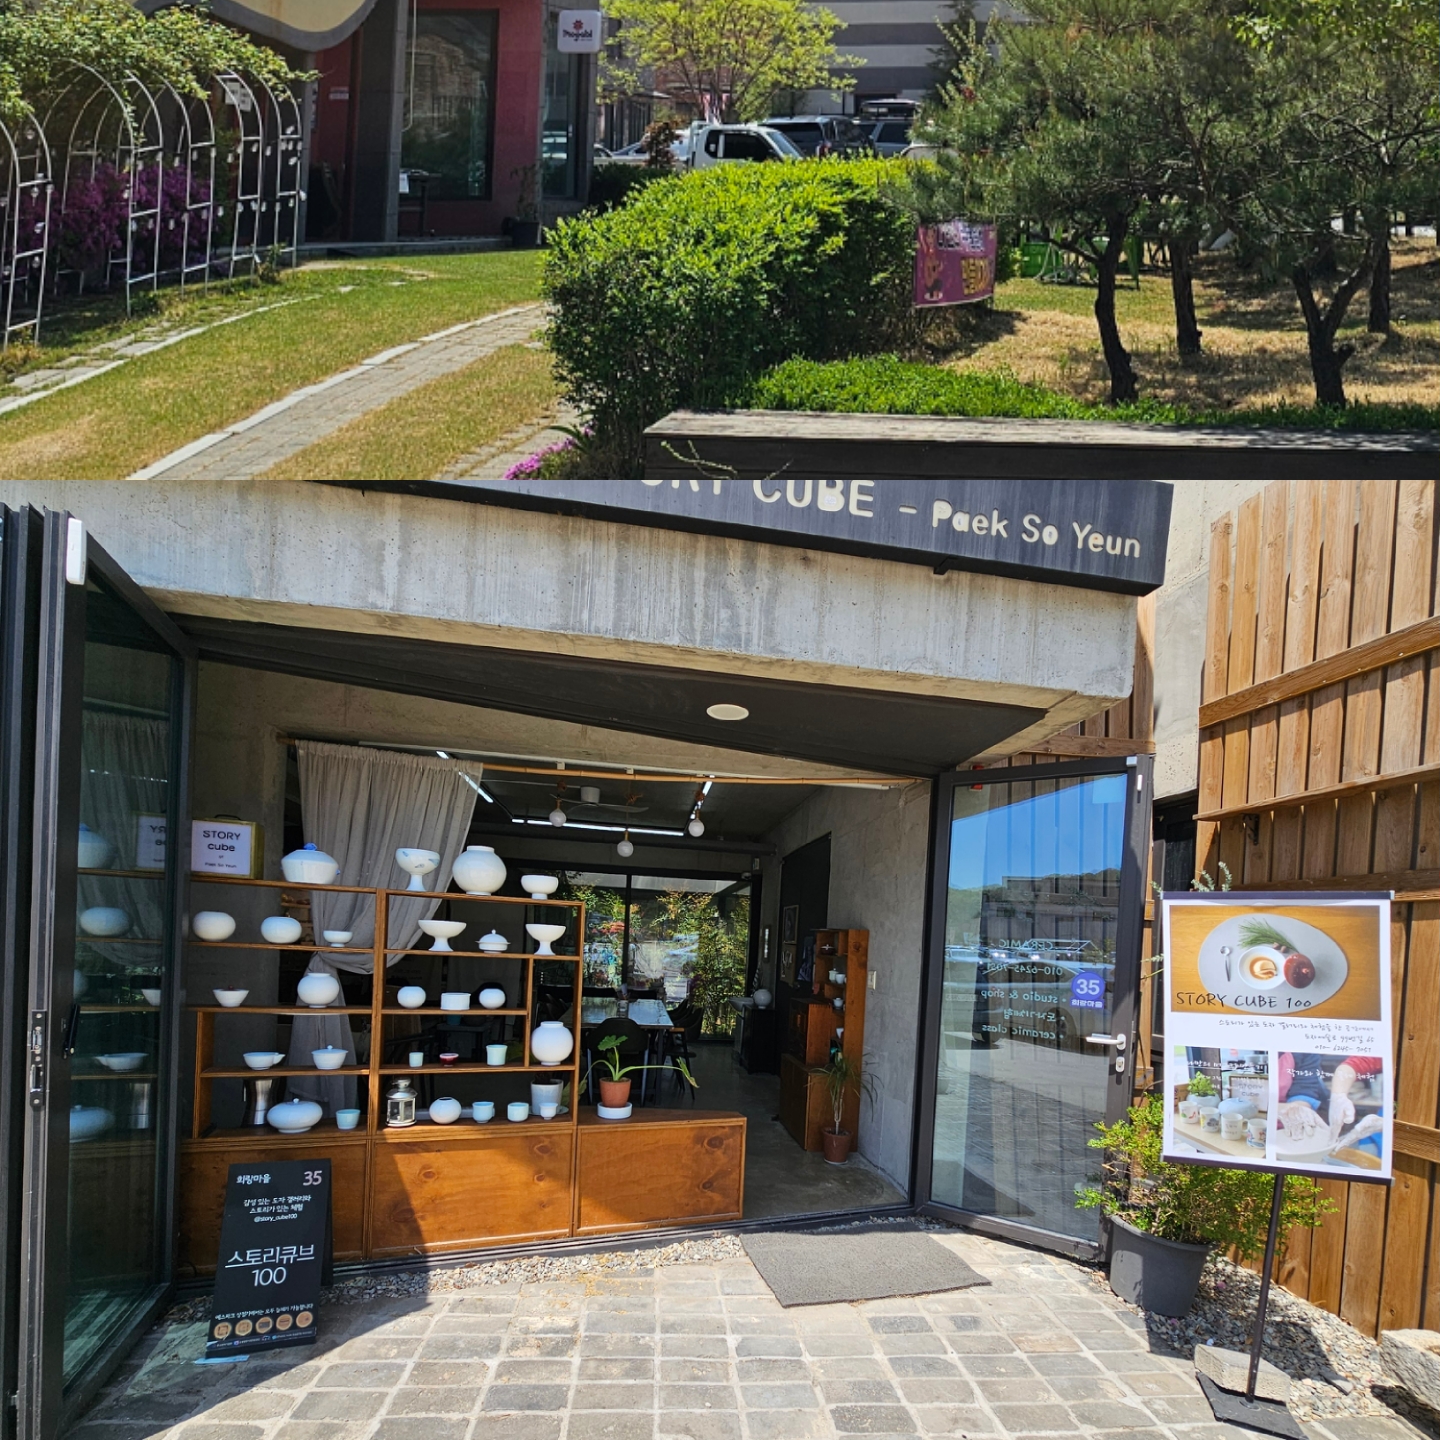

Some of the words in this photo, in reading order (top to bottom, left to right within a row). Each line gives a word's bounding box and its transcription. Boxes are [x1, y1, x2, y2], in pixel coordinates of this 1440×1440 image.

[753, 480, 875, 518] CUBE
[931, 499, 1009, 539] Paek
[1021, 514, 1058, 546] So
[1072, 521, 1141, 558] Yeun
[203, 830, 241, 841] STORY
[207, 843, 236, 851] cube
[1076, 978, 1100, 995] 35
[1176, 991, 1228, 1008] STORY
[1234, 995, 1278, 1009] CUBE
[1286, 997, 1312, 1009] 100
[1286, 1068, 1313, 1077] 작가와
[236, 1173, 271, 1185] 회랑마을
[302, 1170, 323, 1186] 35
[257, 1197, 271, 1205] 있는
[271, 1195, 285, 1204] 도자
[249, 1205, 275, 1214] 스토리가
[276, 1204, 289, 1213] 있는
[253, 1213, 298, 1223] @story_cube100
[225, 1244, 315, 1269] 스토리큐브
[251, 1266, 287, 1287] 100
